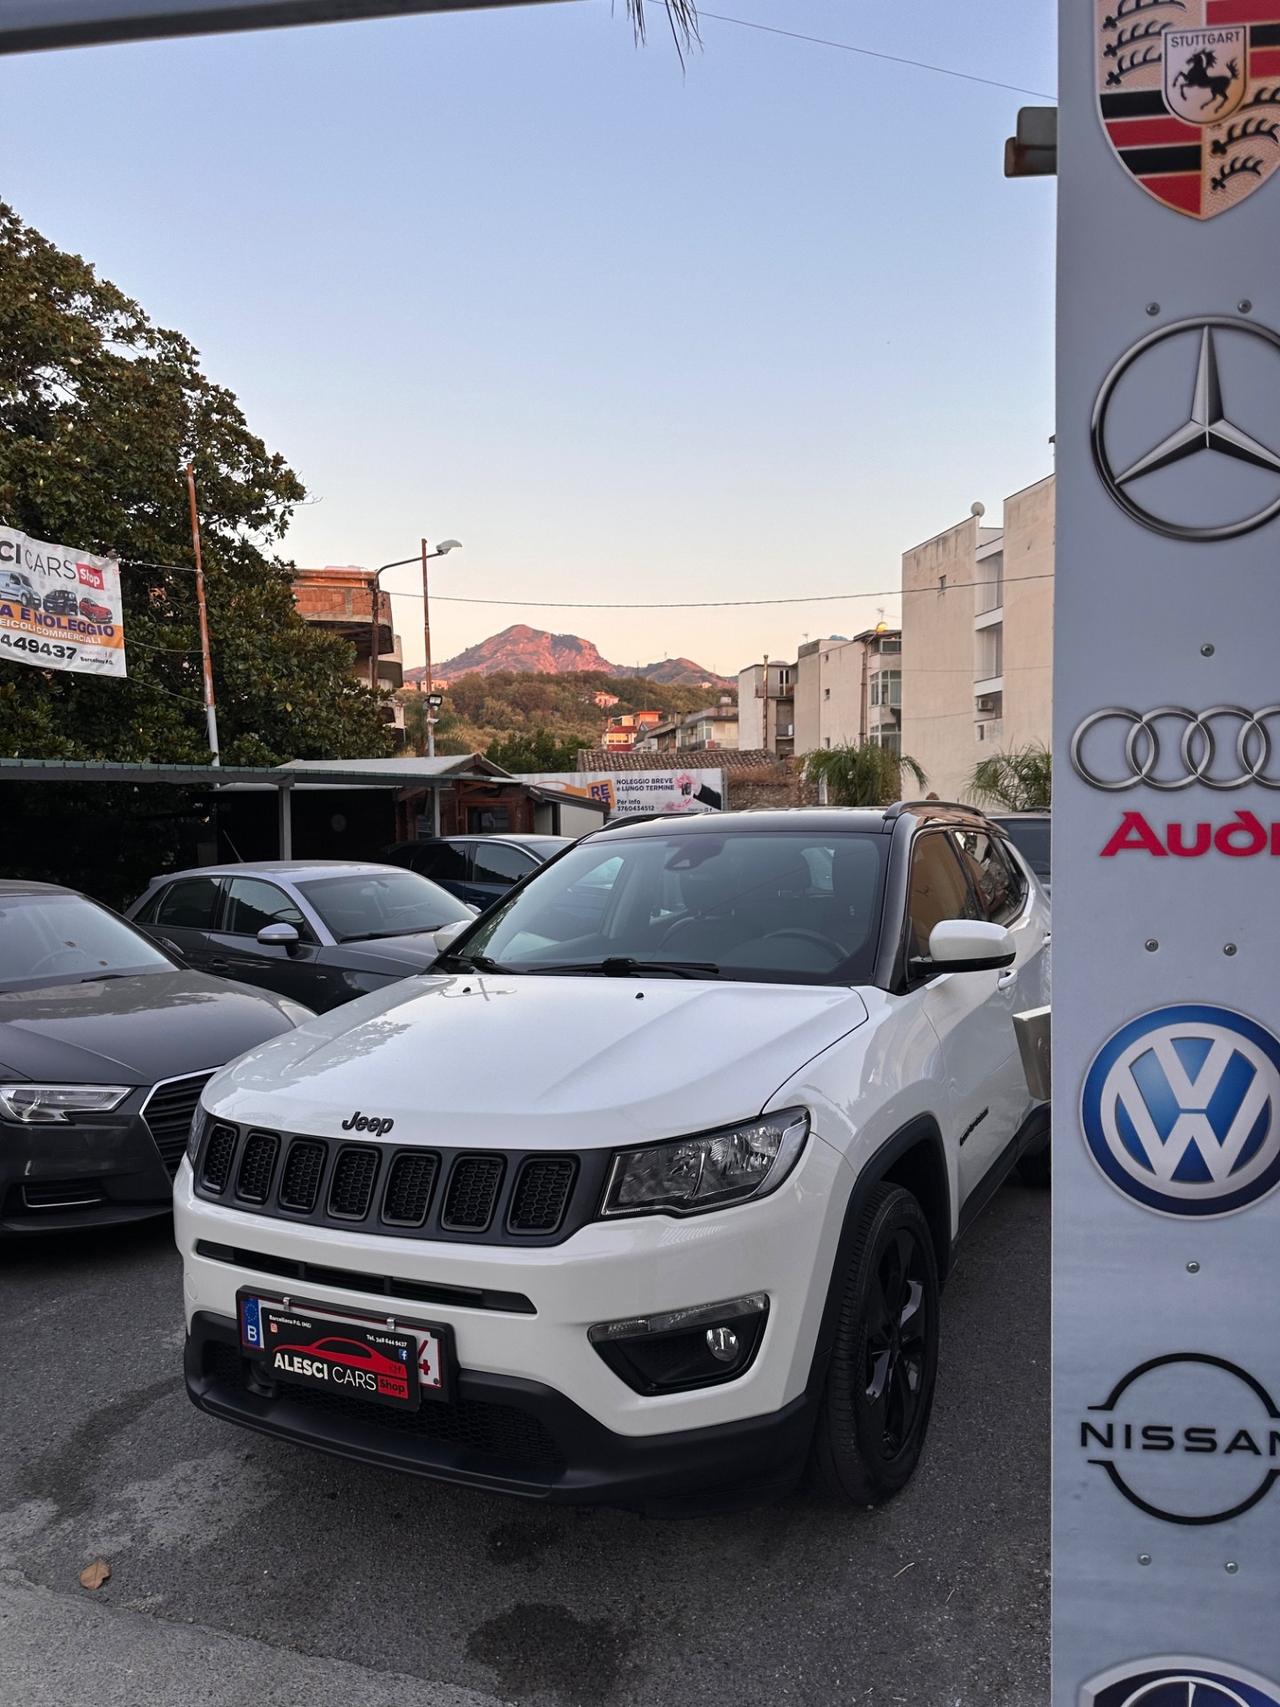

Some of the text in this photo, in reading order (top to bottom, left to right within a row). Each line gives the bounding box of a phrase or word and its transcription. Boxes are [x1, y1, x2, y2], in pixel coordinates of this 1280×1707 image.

[1171, 31, 1241, 48] STUTTGART
[25, 549, 76, 580] CARS
[79, 568, 100, 587] Shop
[21, 608, 31, 621] E
[34, 611, 114, 637] NOLEGGIO
[591, 784, 609, 797] RE
[341, 1110, 394, 1137] Jeep
[247, 1325, 257, 1341] B
[273, 1352, 377, 1392] ALESCI CARS
[379, 1378, 405, 1394] Shop
